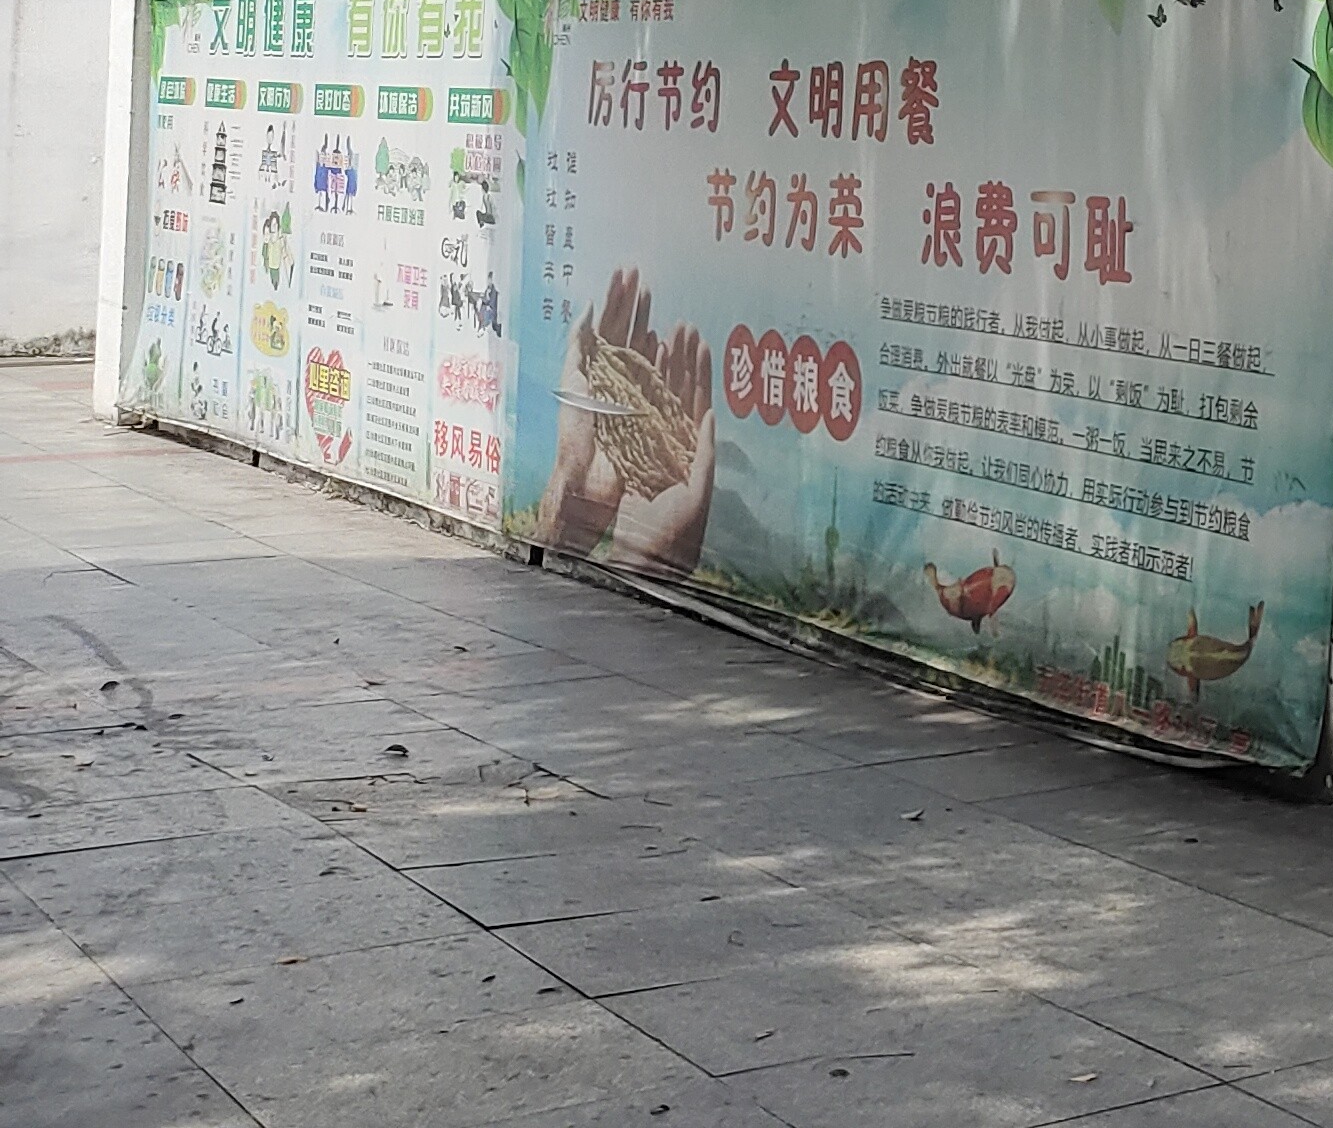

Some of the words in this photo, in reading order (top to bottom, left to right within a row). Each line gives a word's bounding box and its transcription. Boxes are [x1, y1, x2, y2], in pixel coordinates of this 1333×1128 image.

[258, 86, 291, 109] 文明行为
[315, 88, 351, 112] 良好心态
[378, 91, 418, 115] 环境保洁
[449, 93, 493, 119] 共筑新风
[588, 58, 721, 134] 厉行节约
[768, 55, 940, 146] 文明用餐
[706, 167, 865, 259] 节约为荣
[920, 179, 1135, 286] 浪费可耻
[730, 342, 856, 424] 珍惜粮食
[433, 420, 501, 476] 移风易俗
